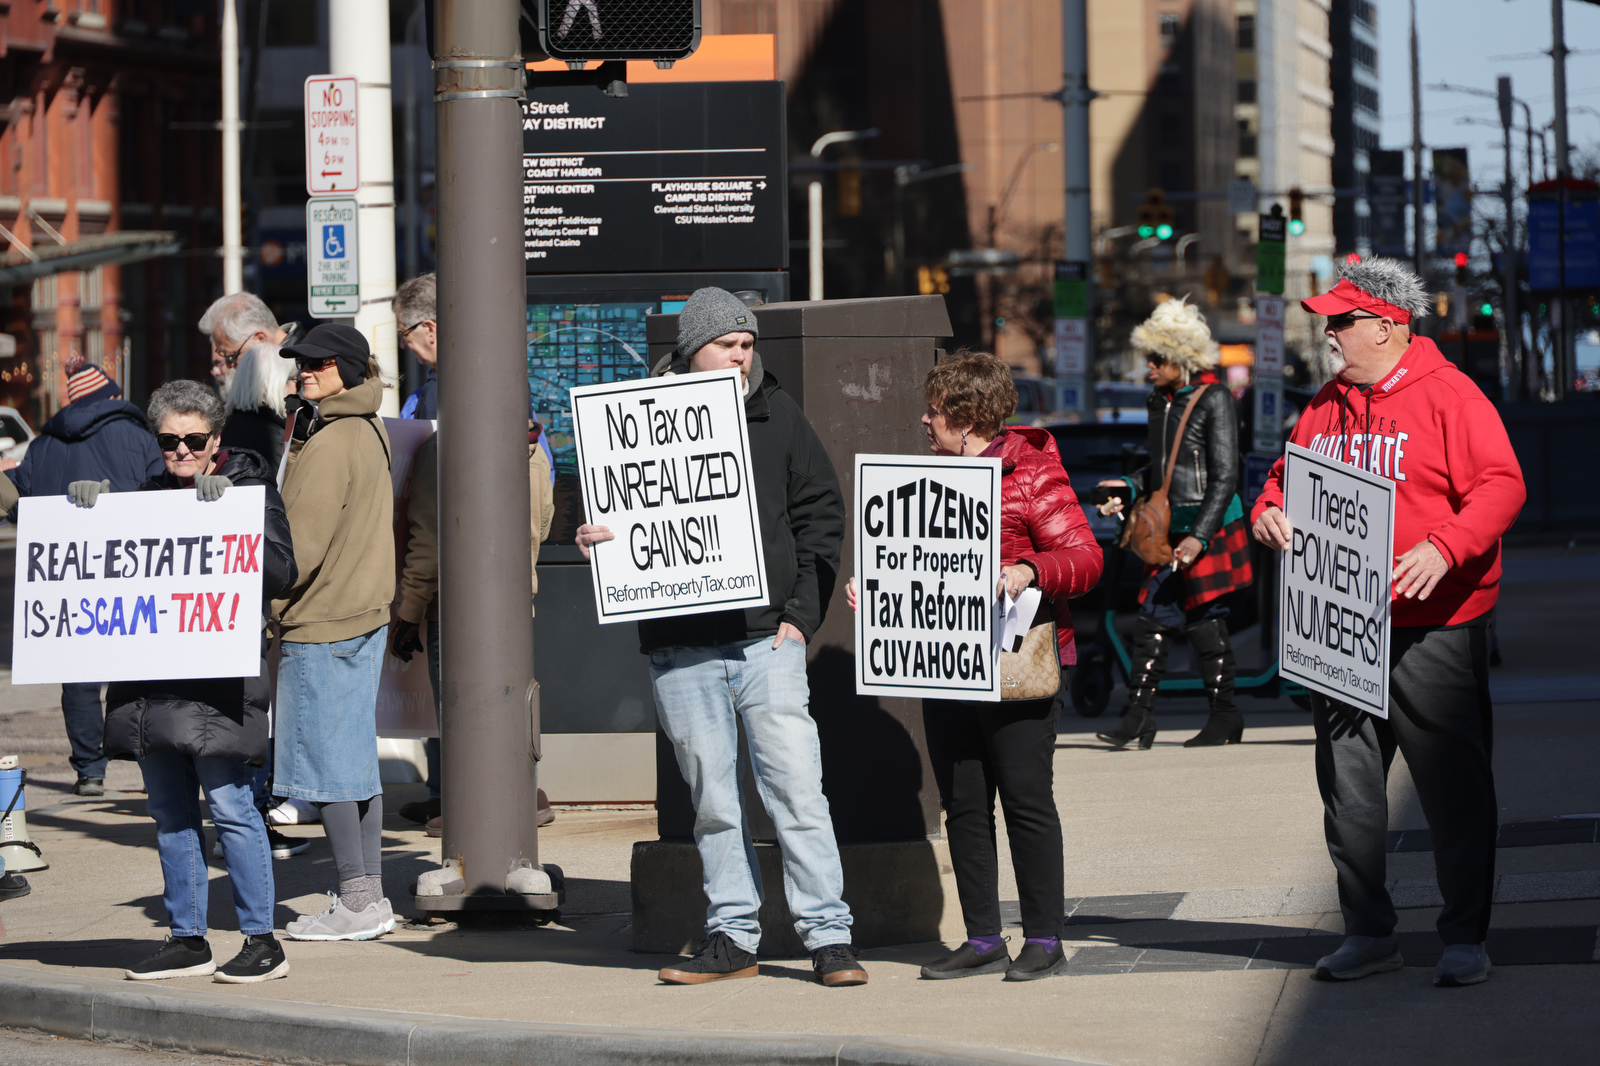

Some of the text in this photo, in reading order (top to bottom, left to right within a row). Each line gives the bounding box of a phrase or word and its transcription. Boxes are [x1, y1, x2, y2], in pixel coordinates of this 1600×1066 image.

[323, 88, 342, 107] NO
[530, 101, 569, 115] Street
[311, 109, 355, 128] STOPPING
[522, 117, 606, 130] AY DISTRICT
[539, 157, 584, 167] DISTRICT
[526, 168, 559, 178] COAST
[560, 167, 602, 177] HARBOR
[555, 184, 595, 194] CENTER
[651, 181, 753, 192] PLAYHOUSE SQUARE
[664, 192, 753, 203] CAMPUS DISTRICT
[313, 208, 353, 222] RESERVED
[530, 206, 563, 214] Arcades
[654, 203, 755, 214] Cleveland State University
[557, 216, 602, 225] FieldHouse
[675, 214, 755, 224] CSU Wolstein Center
[531, 227, 561, 236] Visitors
[561, 226, 588, 236] Center
[554, 238, 581, 247] Casino
[322, 272, 347, 283] PARKING
[605, 398, 713, 451] No Tax on
[1325, 413, 1396, 434] UCKEYES
[1348, 431, 1409, 481] STATE
[591, 451, 741, 514] UNREALIZED
[864, 477, 989, 541] CITIZENS
[1308, 471, 1369, 540] There's
[629, 514, 723, 571] GAINS!!!
[27, 533, 262, 582] REAL-ESTATE-TAX
[876, 544, 983, 581] For Property
[1292, 526, 1380, 607] POWER in
[606, 574, 755, 603] ReformPropertyTax.com
[866, 579, 986, 632] Tax Reform
[1287, 585, 1382, 668] NUMBERS!
[869, 638, 986, 681] CUYAHOGA
[1286, 643, 1381, 698] ReformPropertyTax.com
